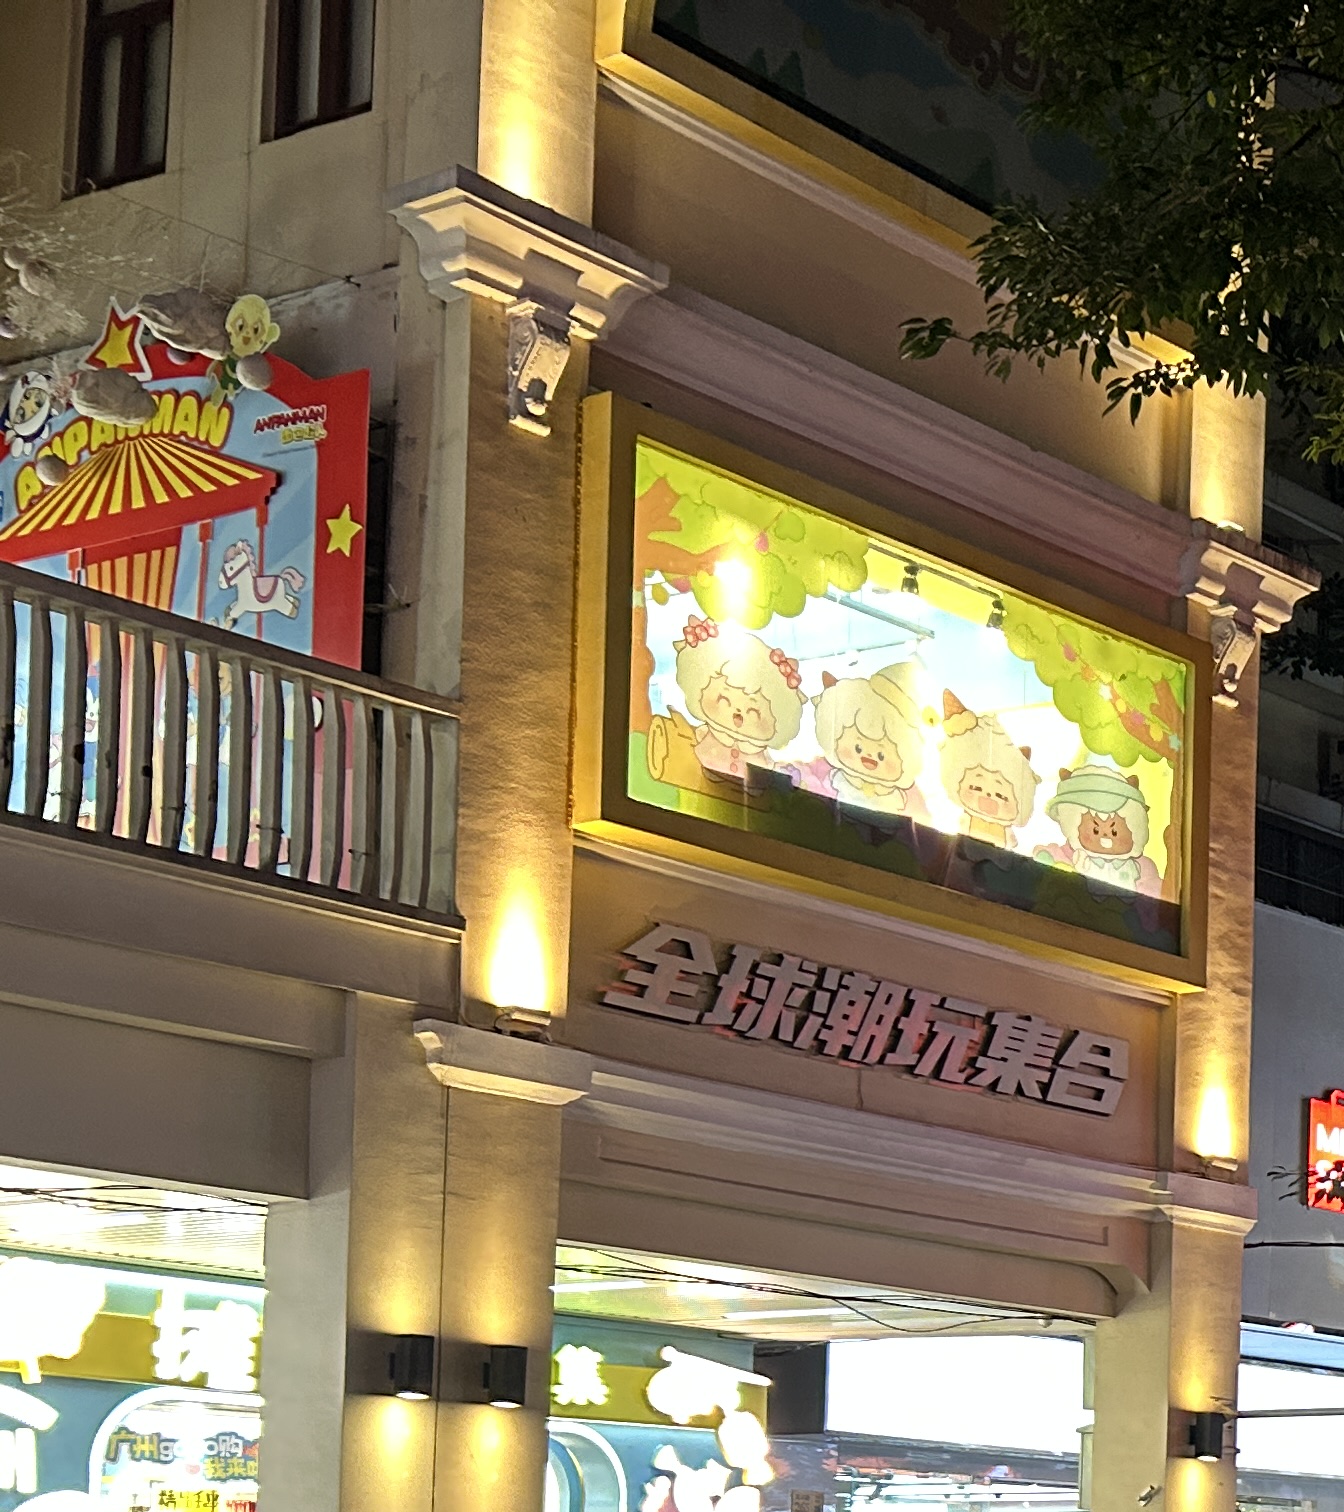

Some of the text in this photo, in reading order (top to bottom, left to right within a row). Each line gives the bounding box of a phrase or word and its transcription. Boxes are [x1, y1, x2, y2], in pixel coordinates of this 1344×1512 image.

[598, 922, 1131, 1117] 全球潮玩集合
[104, 1426, 244, 1462] 广州go购
